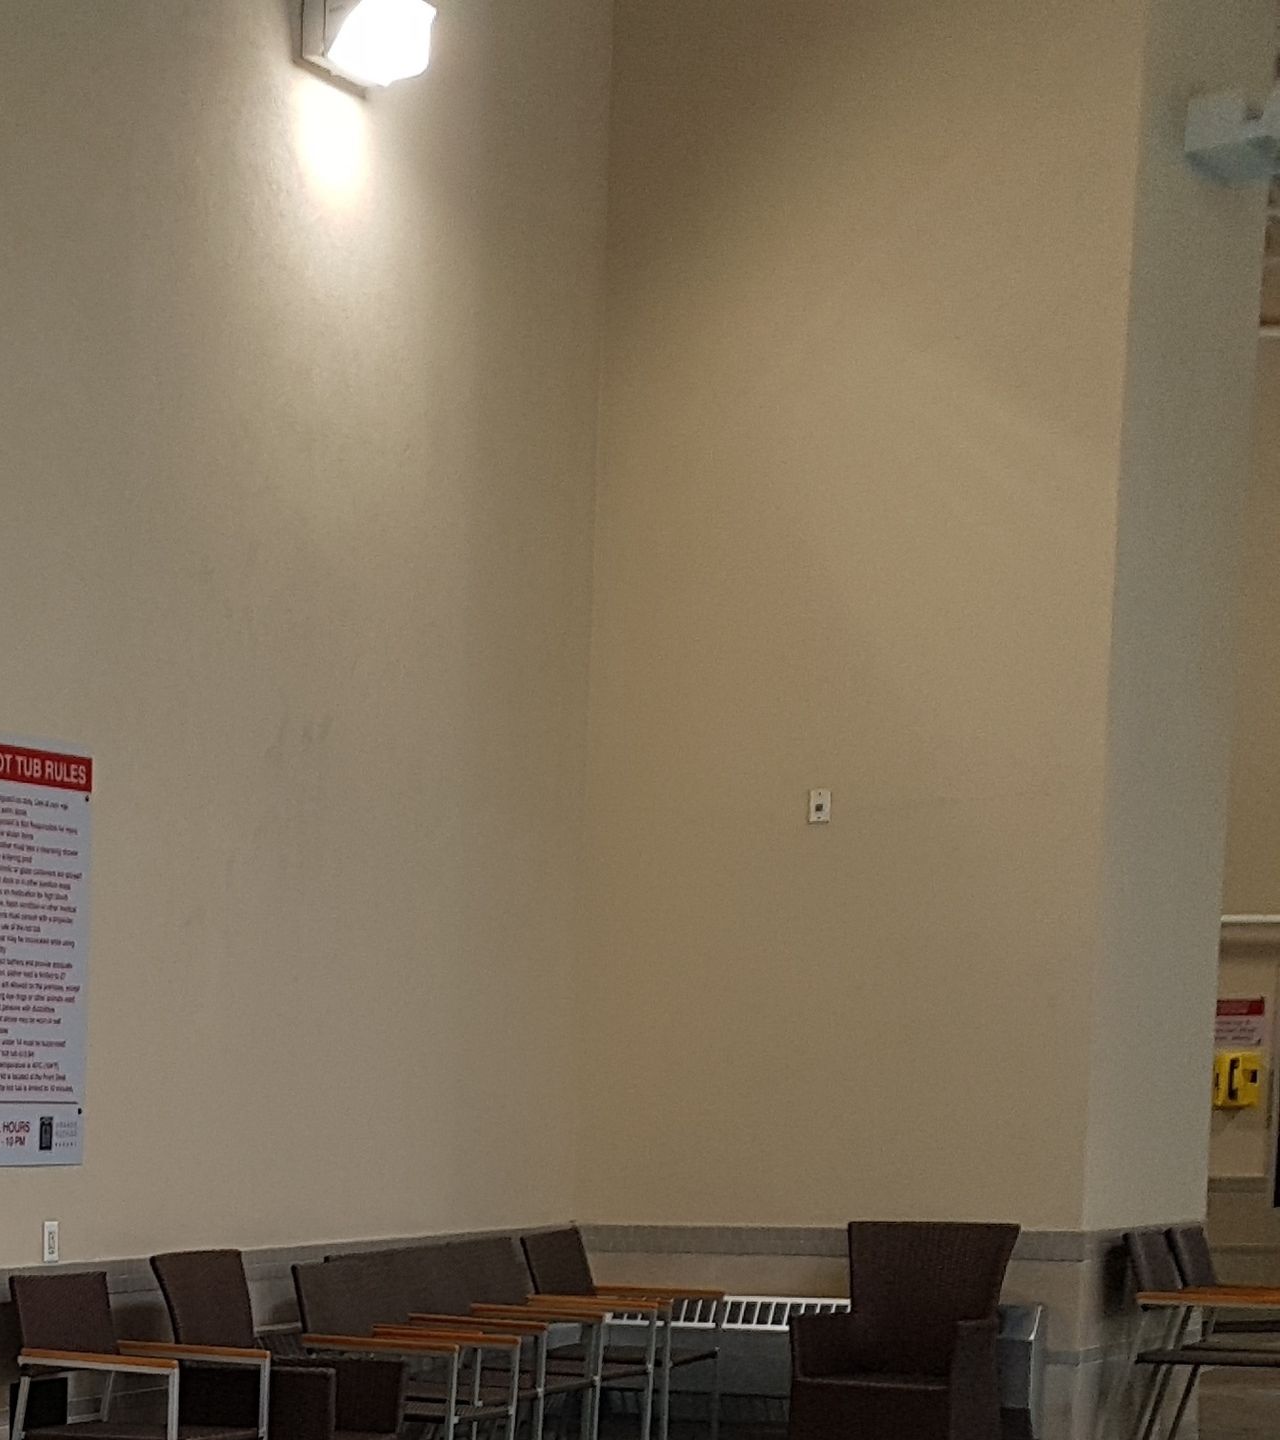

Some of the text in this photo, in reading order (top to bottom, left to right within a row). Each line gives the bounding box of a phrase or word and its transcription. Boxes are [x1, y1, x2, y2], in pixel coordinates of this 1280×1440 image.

[15, 755, 42, 778] TUB
[45, 760, 86, 784] RULES
[3, 1121, 31, 1133] HOURS
[15, 1136, 26, 1147] PM
